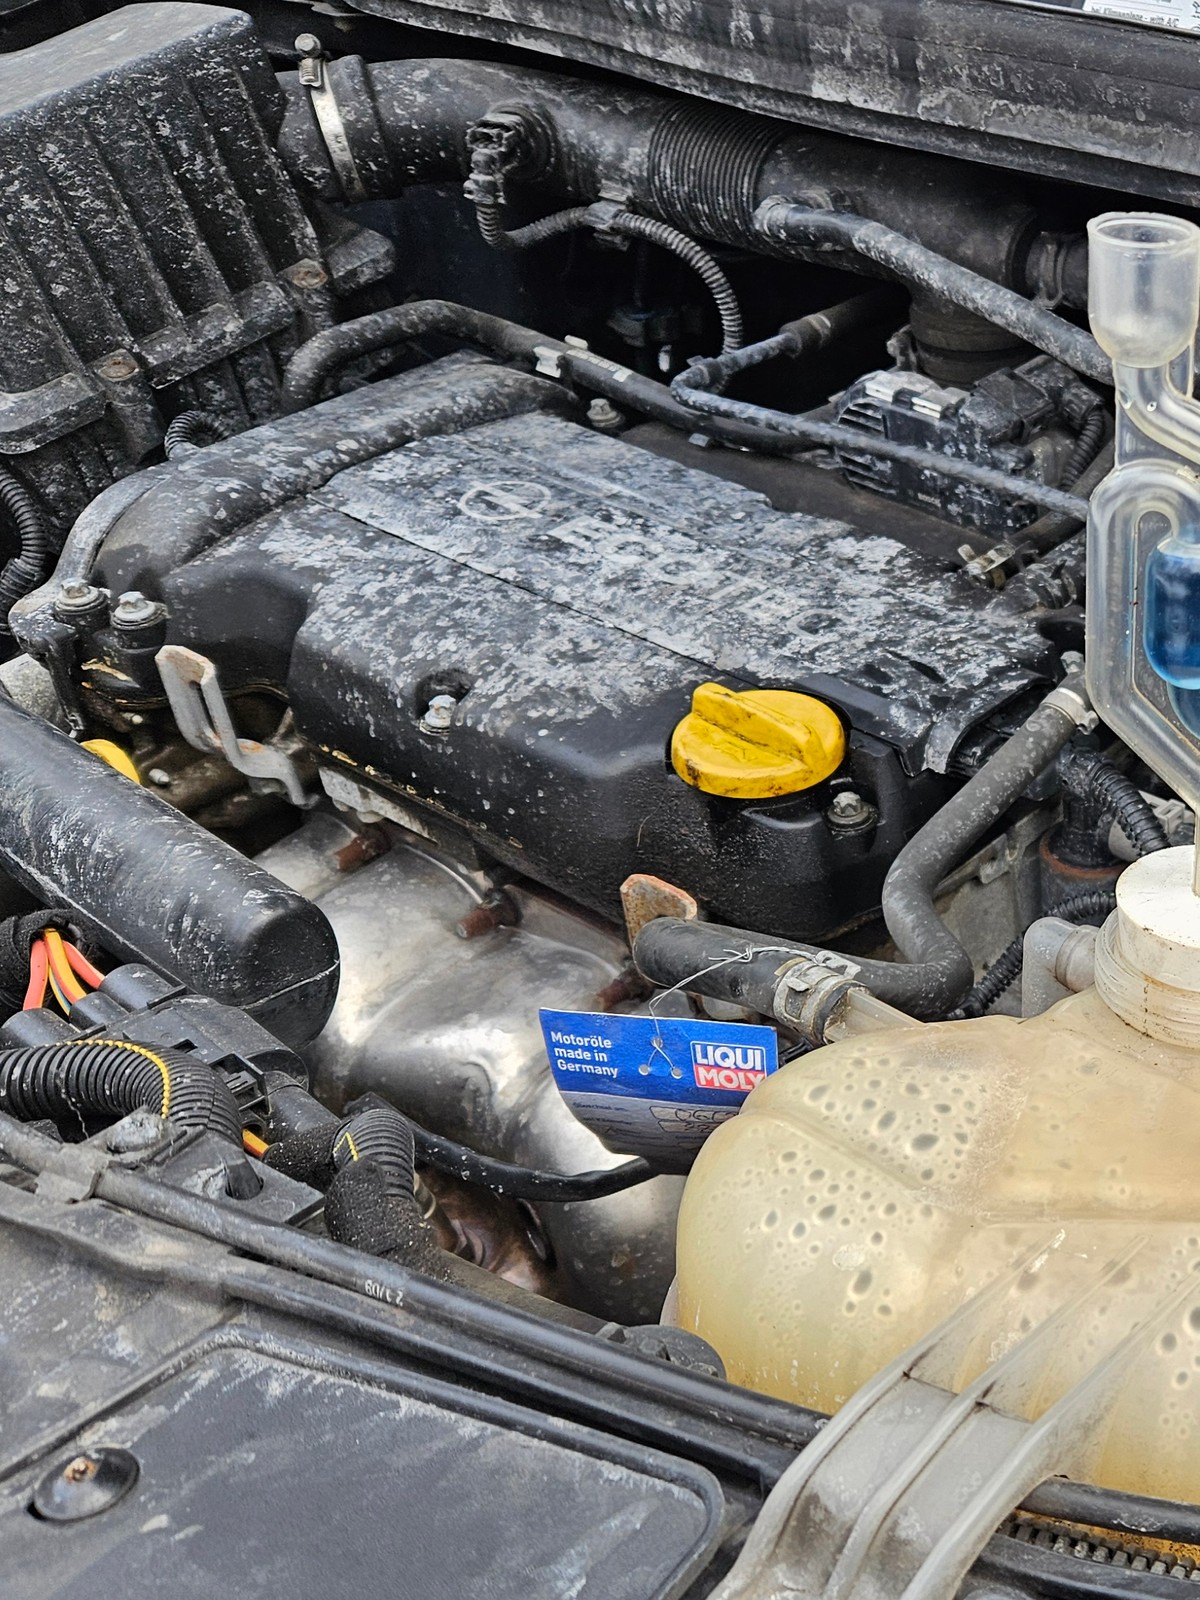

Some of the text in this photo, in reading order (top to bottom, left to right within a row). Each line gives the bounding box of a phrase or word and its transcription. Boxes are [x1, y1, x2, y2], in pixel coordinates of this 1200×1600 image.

[1149, 16, 1164, 26] with
[551, 1031, 612, 1049] Motoröle
[554, 1047, 608, 1063] made in
[695, 1044, 762, 1071] LIQUI
[557, 1060, 618, 1079] Germany
[699, 1067, 766, 1091] MOLY
